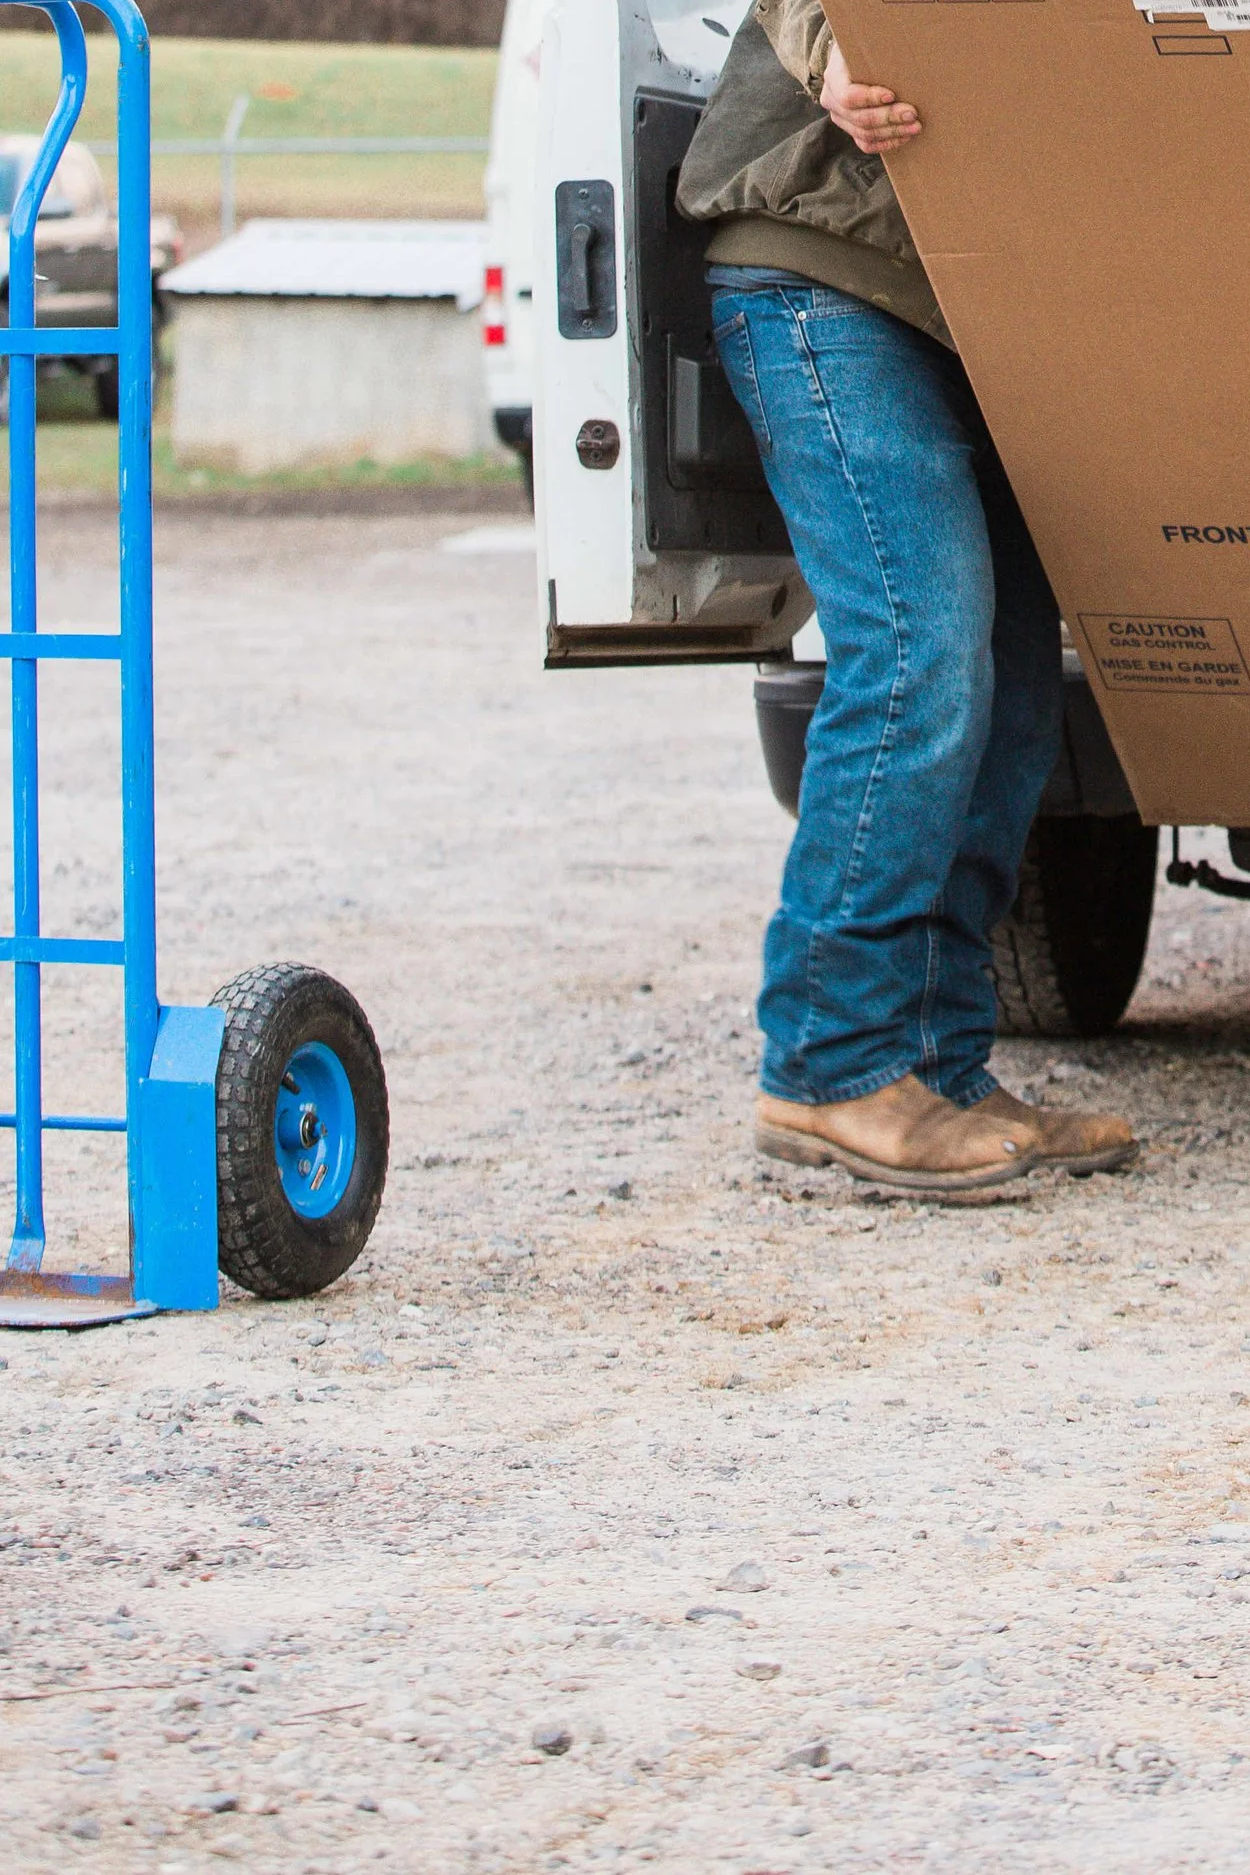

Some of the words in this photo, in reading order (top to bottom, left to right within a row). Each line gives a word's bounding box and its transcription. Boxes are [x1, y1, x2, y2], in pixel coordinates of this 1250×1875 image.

[1107, 622, 1207, 639] CAUTION
[1110, 638, 1141, 648] GAS
[1144, 639, 1217, 652] CONTROL
[1101, 658, 1145, 671] MISE
[1148, 660, 1173, 672] EN
[1177, 661, 1242, 675] GARDE
[1113, 673, 1190, 685] Commande
[1194, 675, 1212, 686] du
